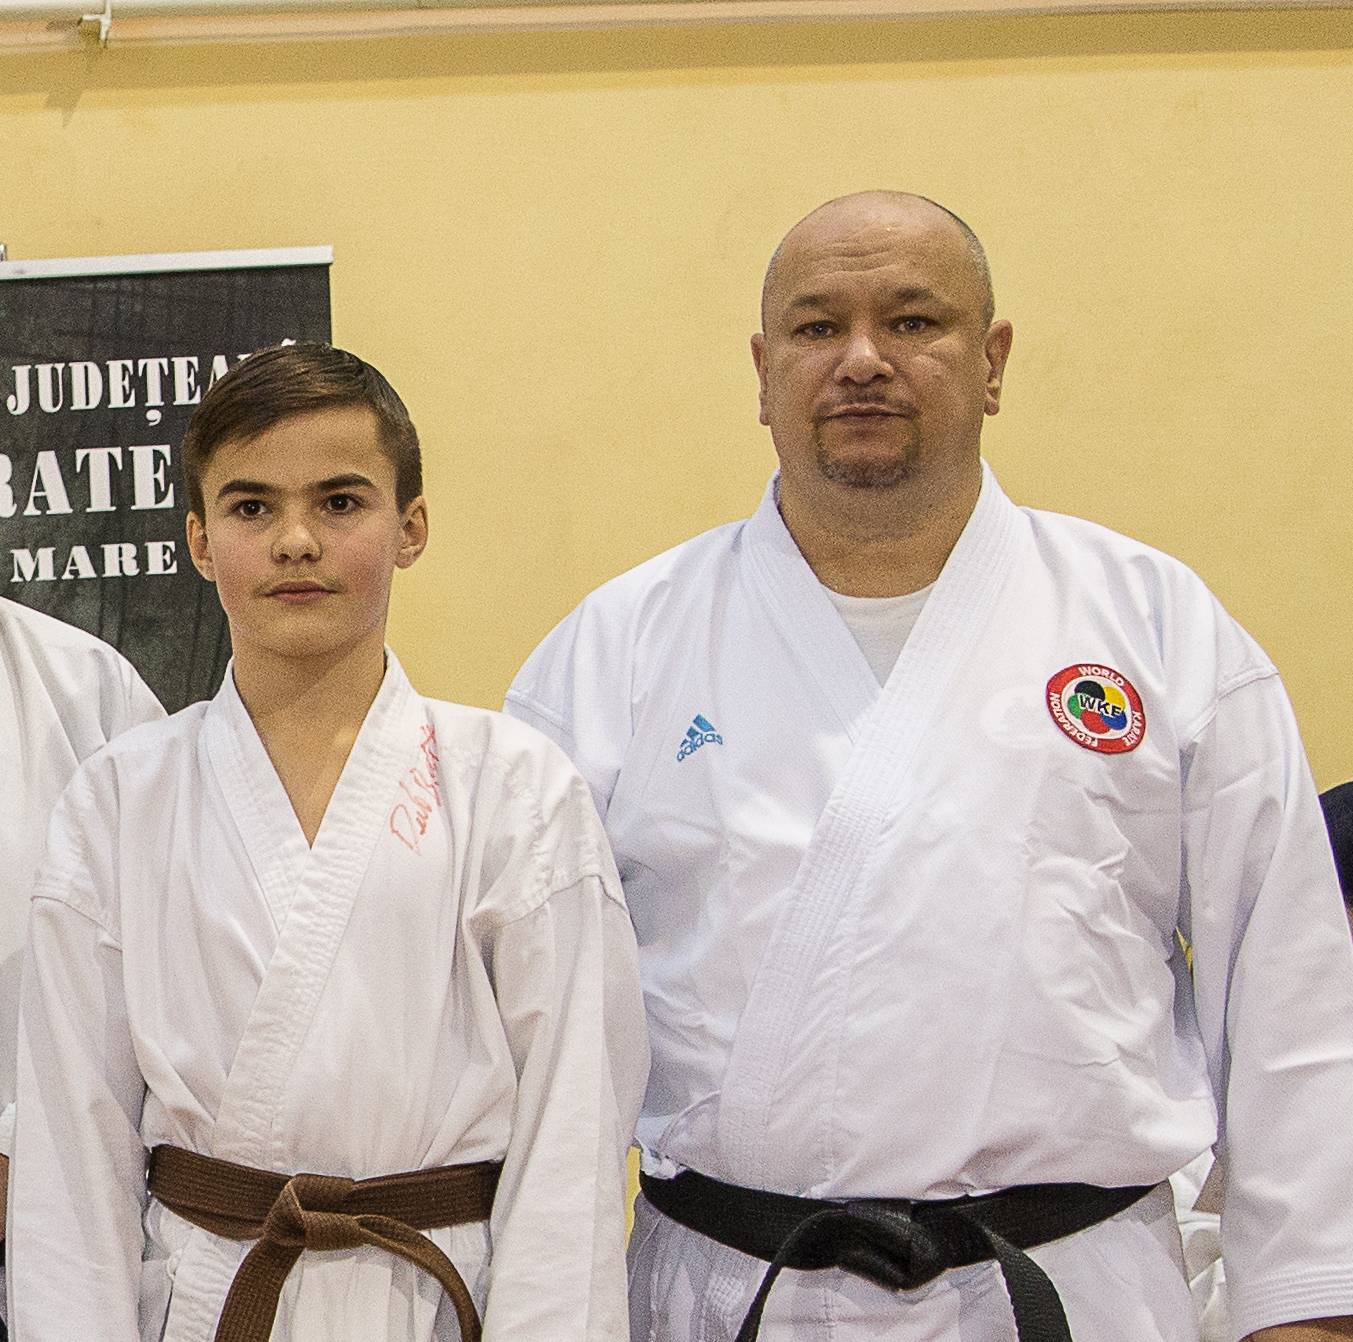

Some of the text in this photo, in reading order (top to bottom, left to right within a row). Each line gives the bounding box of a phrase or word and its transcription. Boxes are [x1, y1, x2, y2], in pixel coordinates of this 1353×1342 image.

[9, 540, 179, 585] MARE
[1077, 665, 1126, 687] WORLD
[1048, 691, 1099, 748] FEDERATION
[1121, 709, 1142, 747] KARATE
